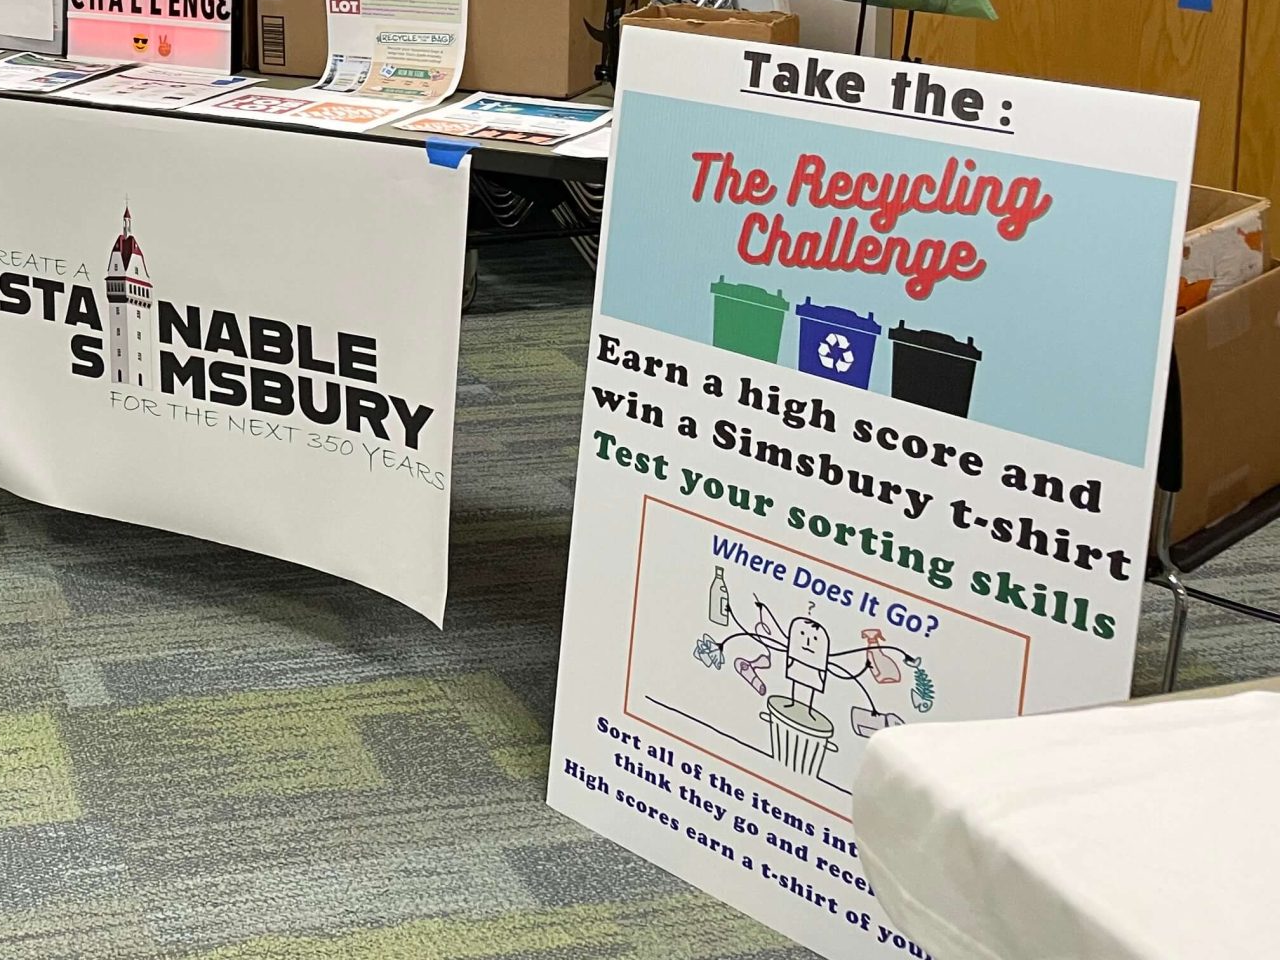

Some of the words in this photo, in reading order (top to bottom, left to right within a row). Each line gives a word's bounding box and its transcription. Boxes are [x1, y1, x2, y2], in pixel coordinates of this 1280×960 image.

[332, 1, 358, 13] LOT
[742, 51, 865, 104] Take
[691, 151, 776, 206] The
[786, 152, 1053, 241] Recycling
[73, 261, 90, 282] A
[737, 212, 987, 301] Challenge
[109, 390, 158, 416] FOR
[167, 403, 219, 428] THE
[228, 416, 300, 444] NEXT
[306, 431, 355, 458] 350
[362, 442, 447, 491] YEARS
[597, 333, 690, 389] Earn
[738, 377, 837, 433] high
[852, 418, 984, 477] score
[1001, 462, 1102, 513] and
[592, 385, 665, 428] win
[713, 420, 934, 520] Simsbury
[950, 499, 1132, 582] t-shirt
[593, 430, 669, 481] Test
[680, 467, 775, 518] your
[788, 504, 956, 590] sorting
[971, 569, 1118, 641] skills
[712, 535, 787, 583] Where
[792, 566, 854, 608] Does
[886, 601, 941, 640] Go?
[597, 716, 641, 750] Sort
[647, 742, 674, 767] all
[709, 772, 744, 801] the
[751, 792, 815, 837] items
[614, 753, 672, 793] think
[679, 784, 727, 821] they
[767, 830, 809, 862] and
[564, 758, 609, 795] High
[616, 788, 680, 831] scores
[686, 826, 735, 861] earn
[761, 862, 838, 914] t-shirt
